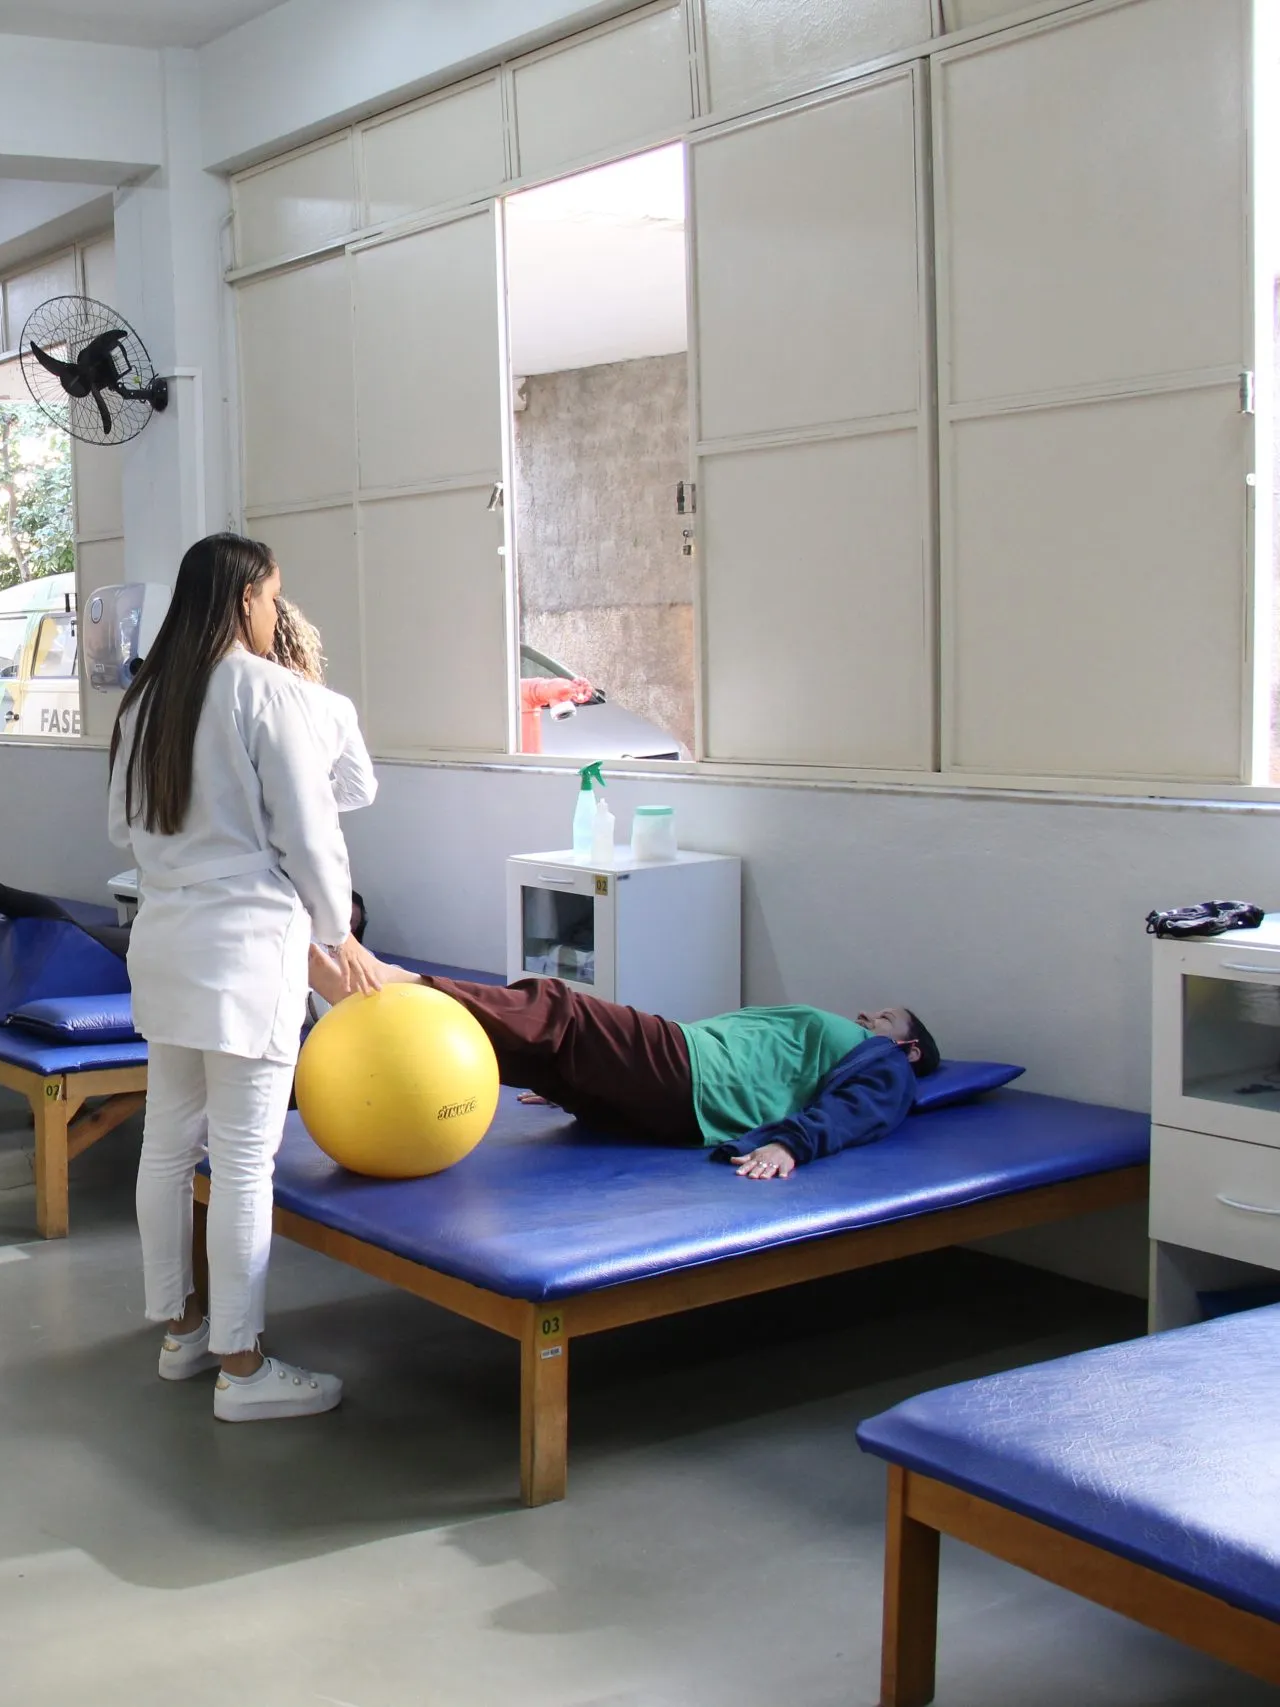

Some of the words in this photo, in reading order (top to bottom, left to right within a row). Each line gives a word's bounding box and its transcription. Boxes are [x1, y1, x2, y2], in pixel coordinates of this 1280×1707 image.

[40, 708, 80, 734] FASE
[596, 880, 608, 892] 02
[542, 1316, 560, 1335] 03
